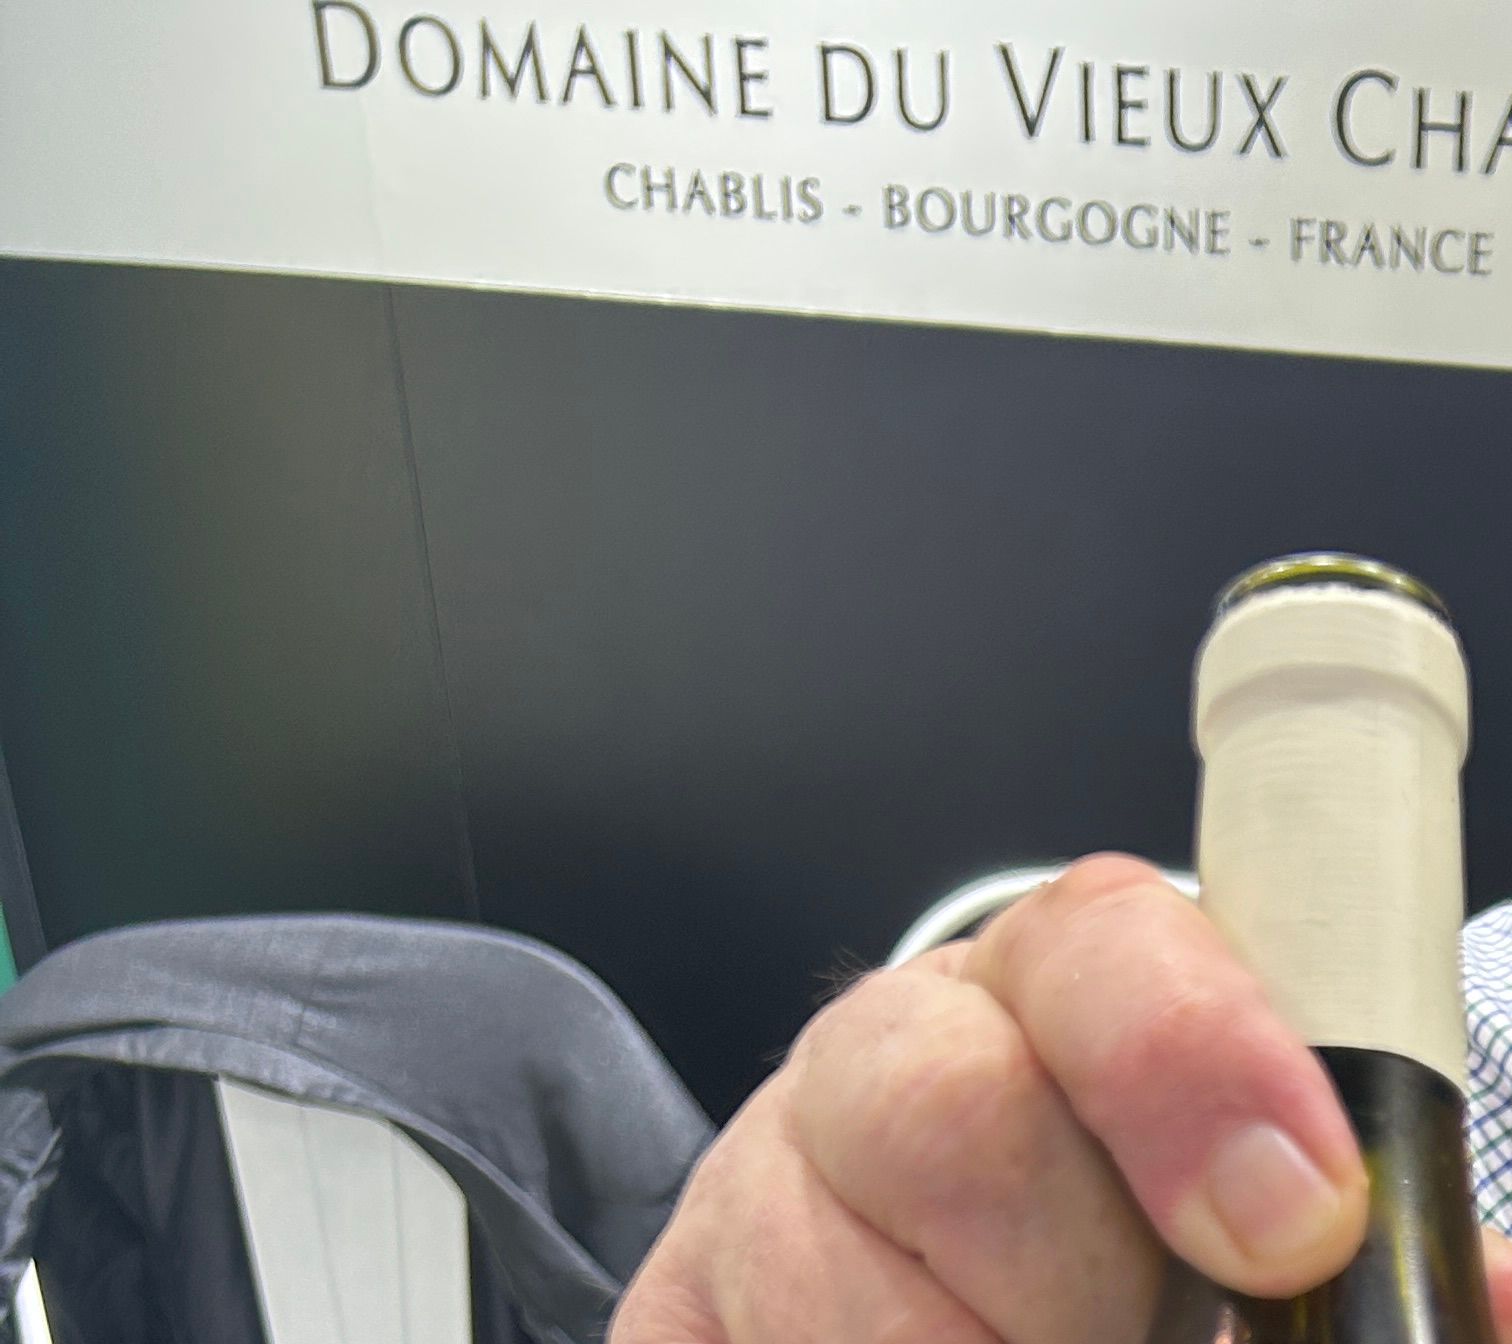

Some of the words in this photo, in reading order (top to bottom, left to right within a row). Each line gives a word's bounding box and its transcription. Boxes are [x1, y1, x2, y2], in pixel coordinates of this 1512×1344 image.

[312, 0, 775, 118] DOMAINE
[818, 41, 950, 134] DU
[996, 42, 1289, 160] VIEUX
[602, 161, 825, 226] CHABLIS
[883, 183, 1232, 256] BOURGOGNE
[1289, 216, 1495, 276] FRANCE
